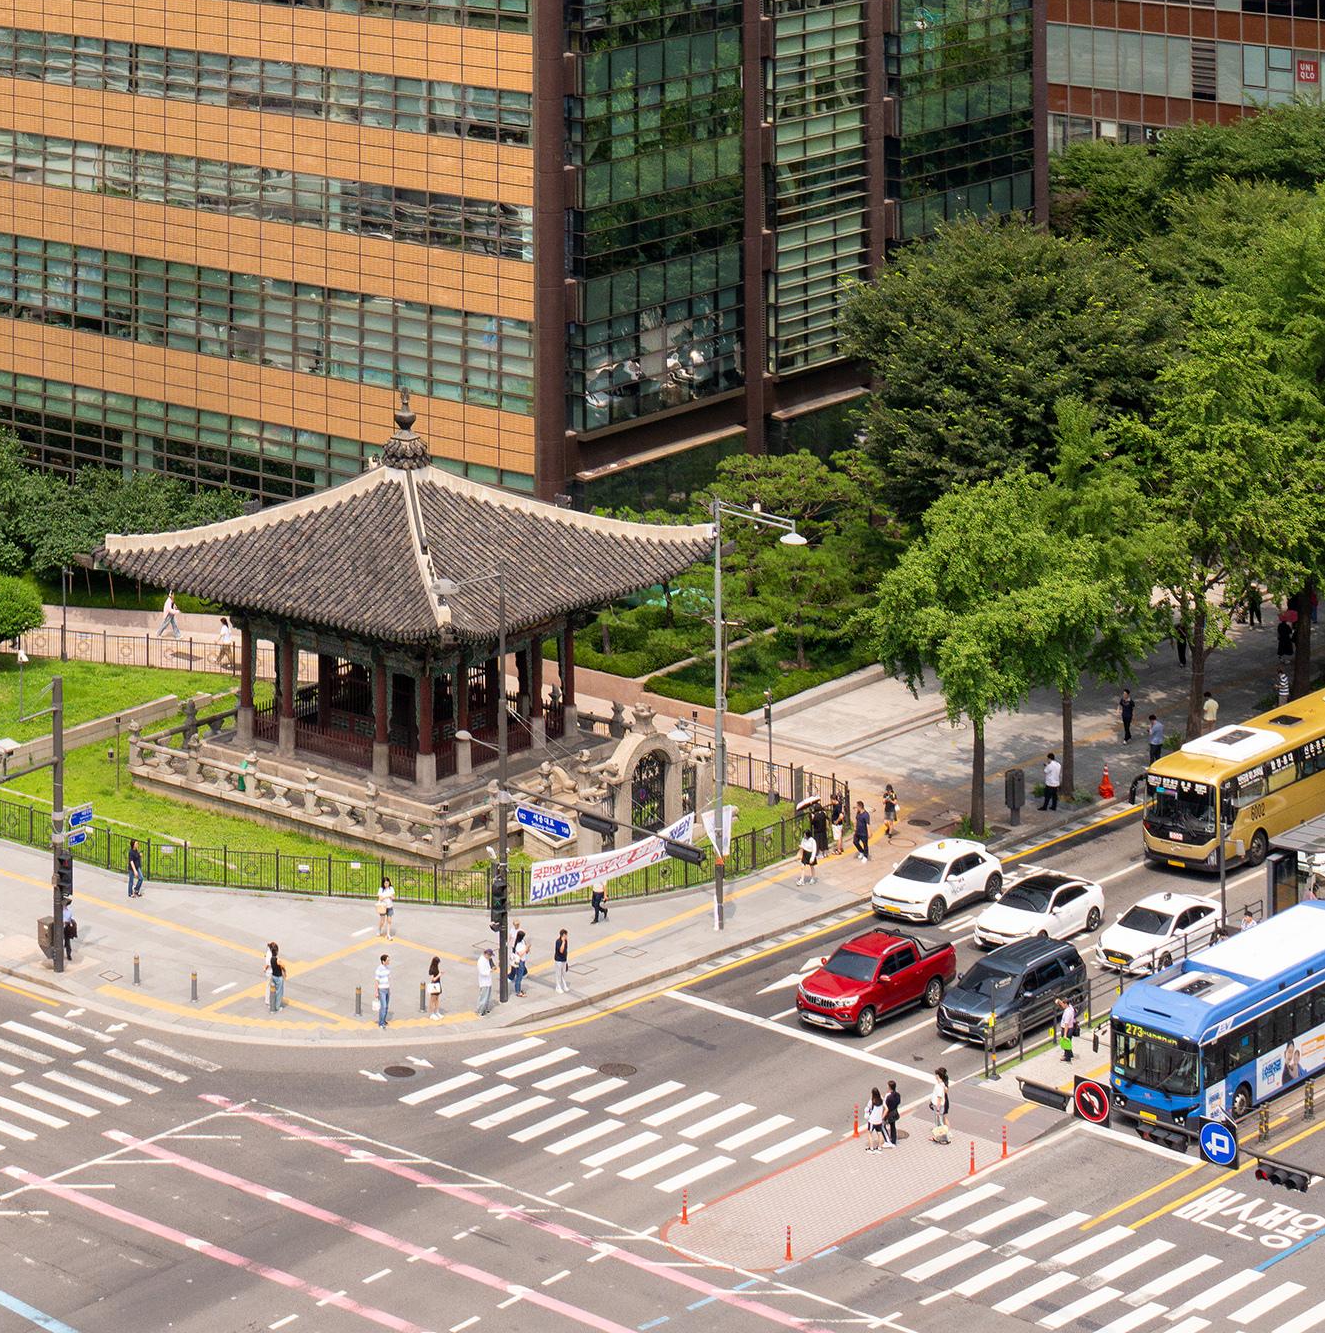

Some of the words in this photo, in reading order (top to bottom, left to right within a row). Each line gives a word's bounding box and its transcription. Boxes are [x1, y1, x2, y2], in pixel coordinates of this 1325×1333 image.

[1300, 63, 1314, 71] UNI
[1300, 71, 1316, 80] QLO
[533, 813, 555, 827] 세종대로
[531, 869, 581, 903] 뇌사판정
[1125, 1022, 1143, 1038] 273
[1171, 1186, 1325, 1249] 버스전용
